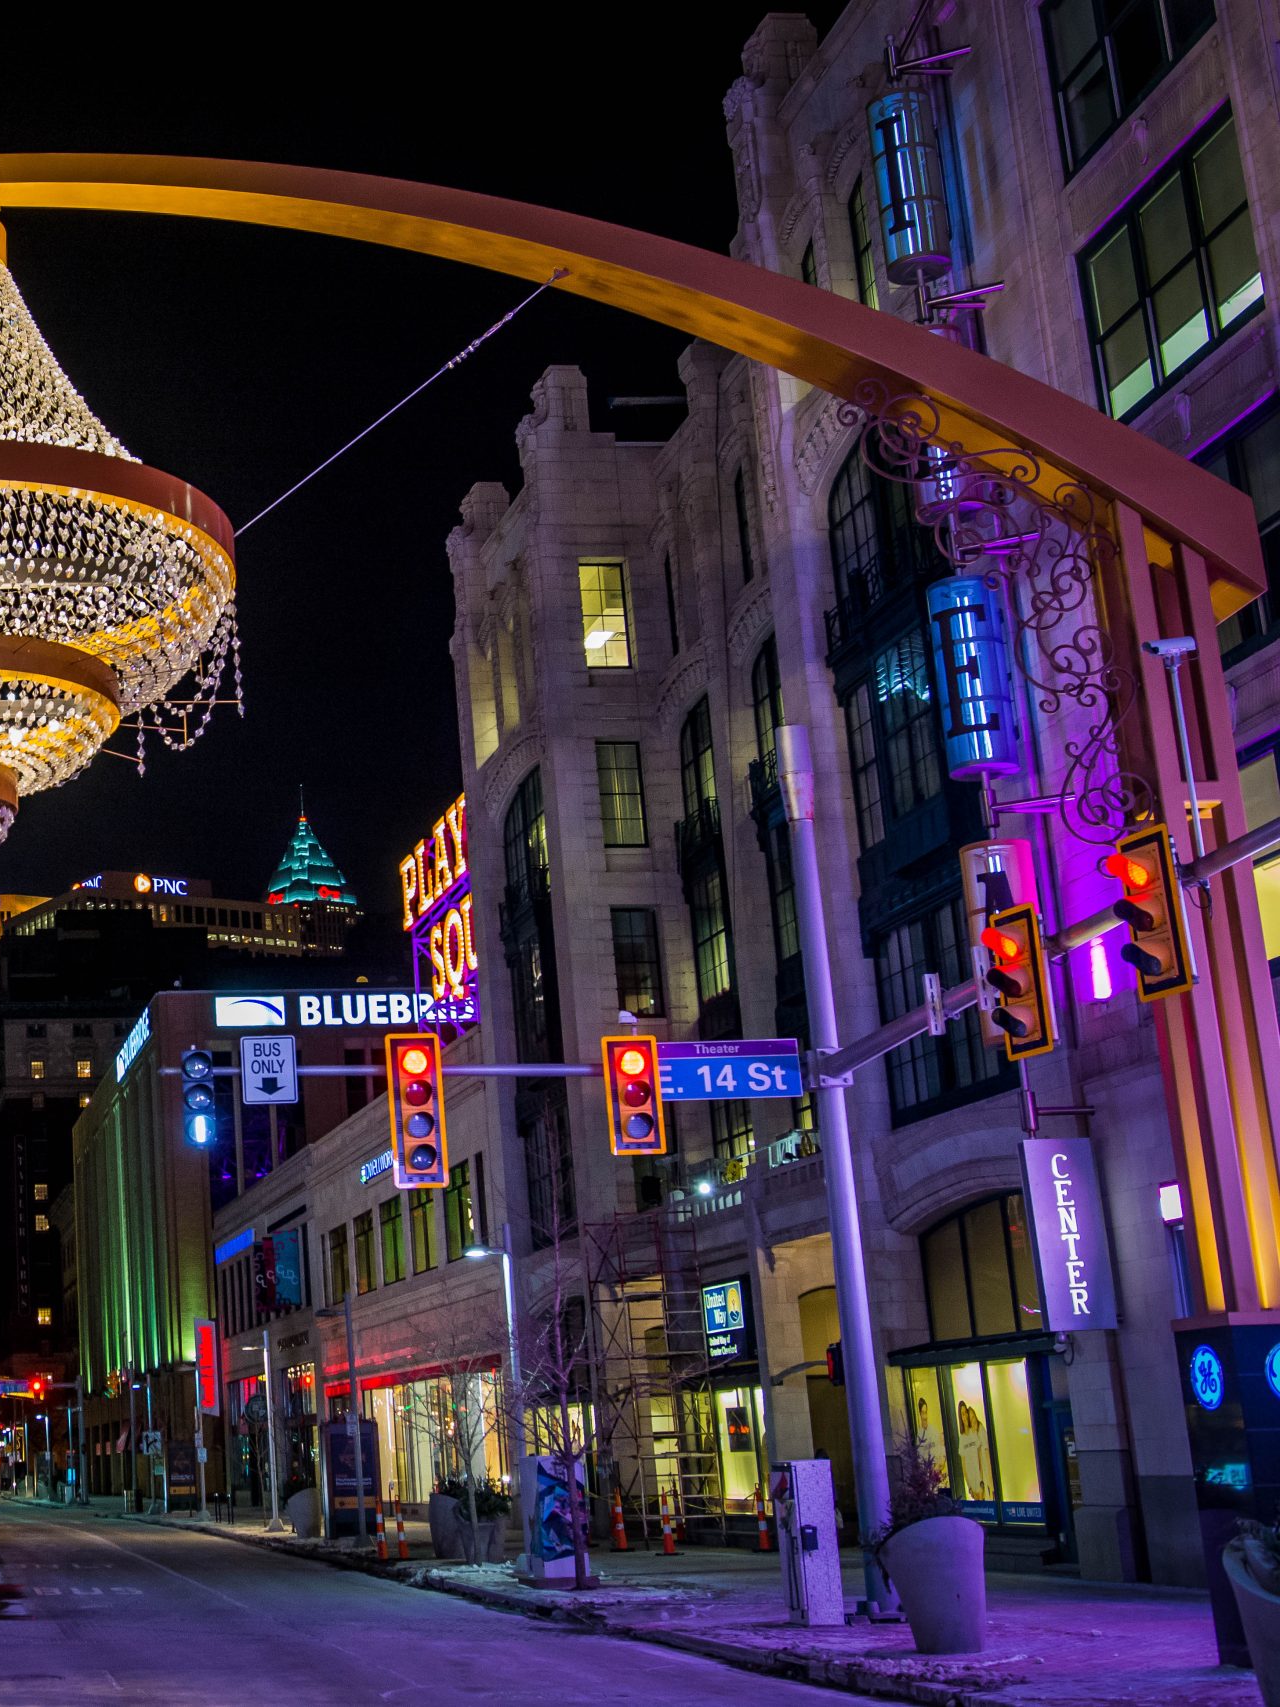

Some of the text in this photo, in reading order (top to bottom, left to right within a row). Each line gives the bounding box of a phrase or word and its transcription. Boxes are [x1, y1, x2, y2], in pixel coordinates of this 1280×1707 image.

[399, 792, 468, 931] PLAY
[152, 877, 188, 896] PNC
[253, 1042, 282, 1058] BUS
[694, 1044, 740, 1055] Theater
[251, 1059, 286, 1075] ONLY
[697, 1064, 737, 1093] 14
[747, 1062, 788, 1092] St
[1050, 1153, 1091, 1316] CENTER
[705, 1290, 725, 1309] United
[714, 1309, 727, 1328] Way
